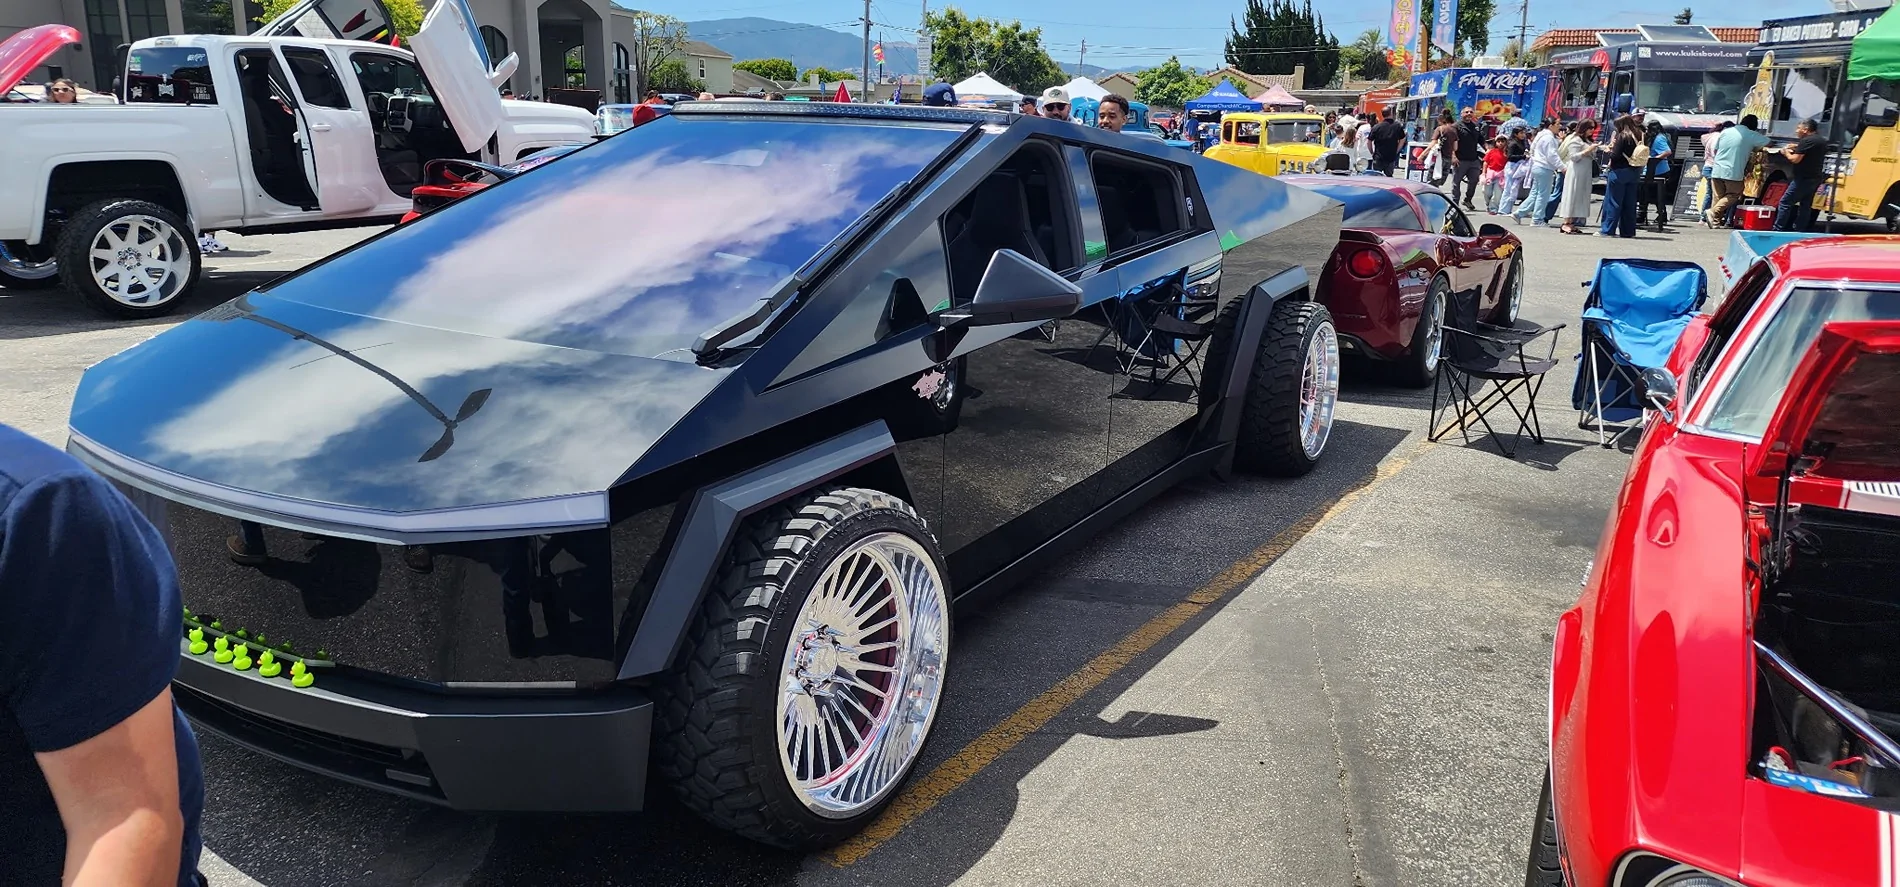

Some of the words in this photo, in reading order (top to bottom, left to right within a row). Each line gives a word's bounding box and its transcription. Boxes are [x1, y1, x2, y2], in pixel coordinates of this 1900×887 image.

[1759, 27, 1781, 43] LOED
[1781, 25, 1802, 41] BAKED
[1801, 22, 1834, 40] POTATOES
[1838, 19, 1860, 37] CORN
[1655, 49, 1743, 58] www.kukisbowl.com
[1458, 72, 1494, 90] Fruit
[1492, 71, 1537, 89] Rider
